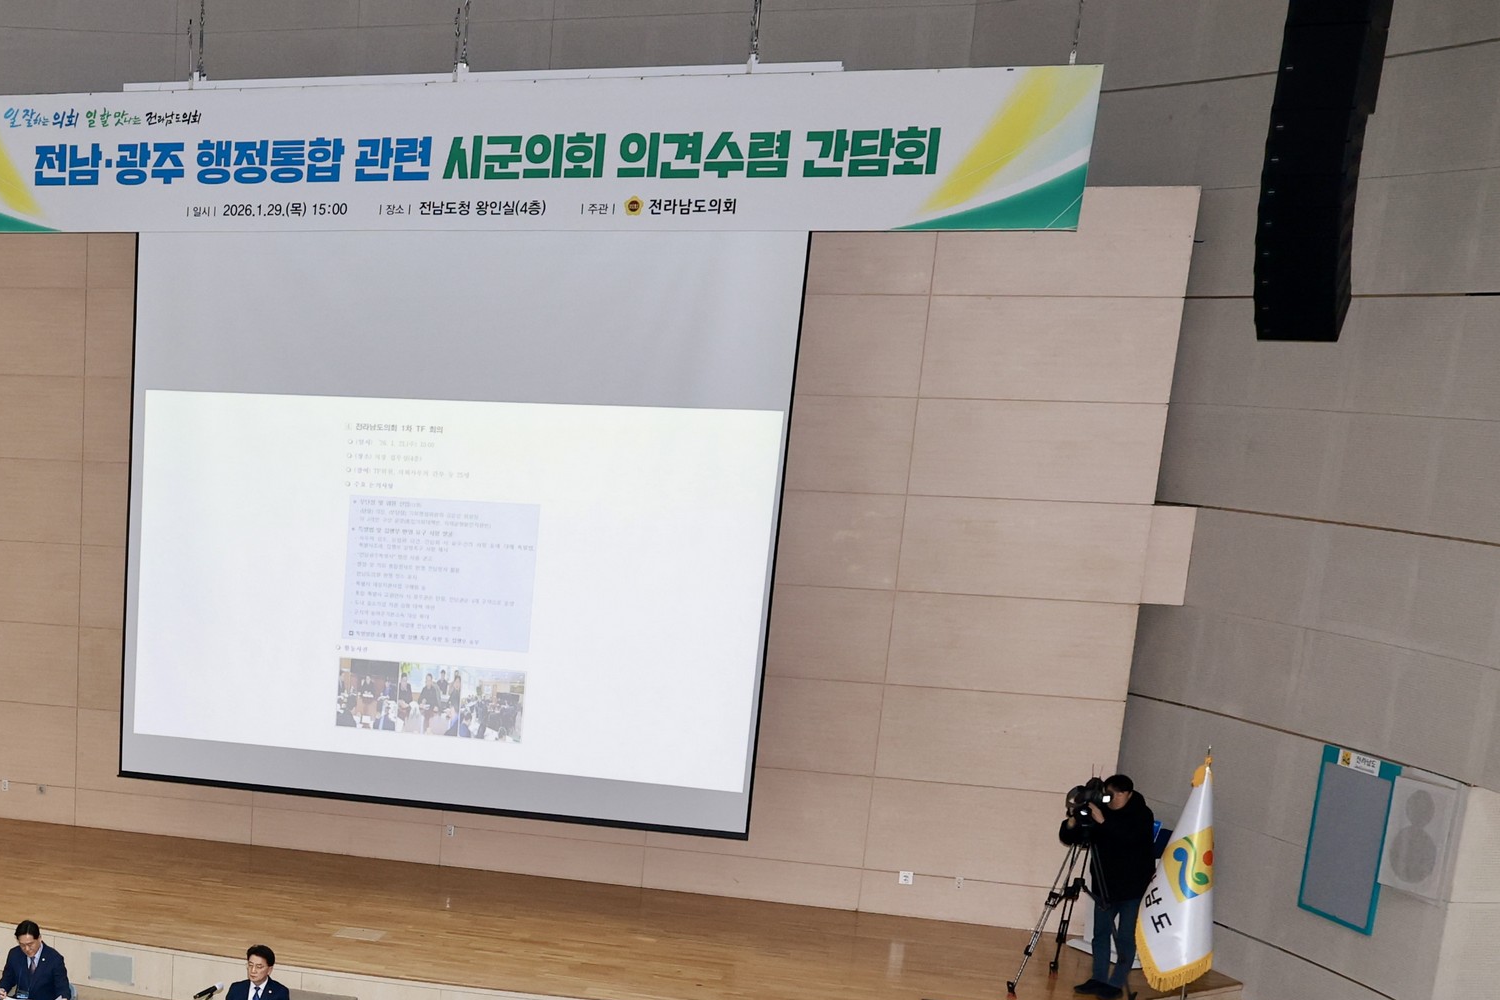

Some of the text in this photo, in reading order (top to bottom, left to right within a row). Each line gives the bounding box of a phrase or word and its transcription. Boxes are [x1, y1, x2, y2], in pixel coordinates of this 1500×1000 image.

[4, 107, 21, 128] 일
[22, 108, 50, 128] 잘하는
[52, 108, 80, 129] 의회
[85, 109, 98, 128] 일
[145, 109, 202, 127] 전라남도의회
[34, 126, 942, 187] 전남·광주 행정통합 관련 시군의회 의견수렴 간담회
[222, 202, 348, 218] 2026.1.29.(목) 15:00
[418, 199, 547, 217] 전남도청 왕인실(4층)
[587, 203, 609, 215] 주관
[648, 198, 737, 216] 전라남도의회
[355, 422, 398, 433] 전라남도의회
